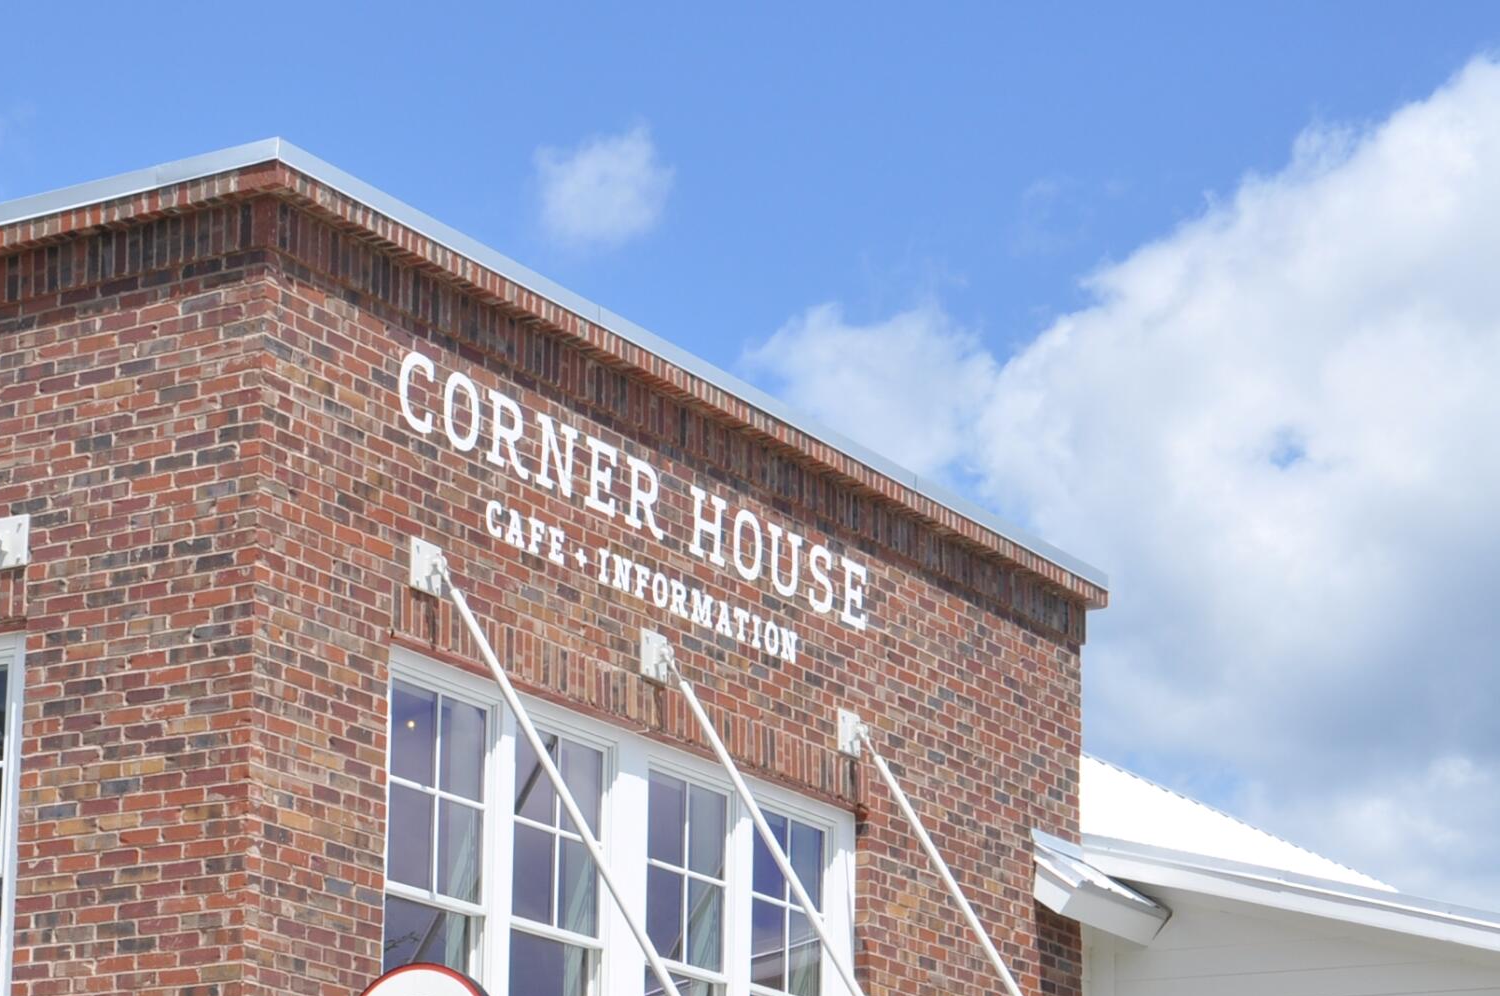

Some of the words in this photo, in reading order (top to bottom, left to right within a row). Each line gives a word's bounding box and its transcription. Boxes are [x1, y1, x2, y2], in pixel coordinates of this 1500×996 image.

[399, 351, 663, 540] CORNER
[689, 485, 868, 631] HOUSE
[485, 500, 565, 567] CAFE
[598, 547, 798, 664] INFORMATION
